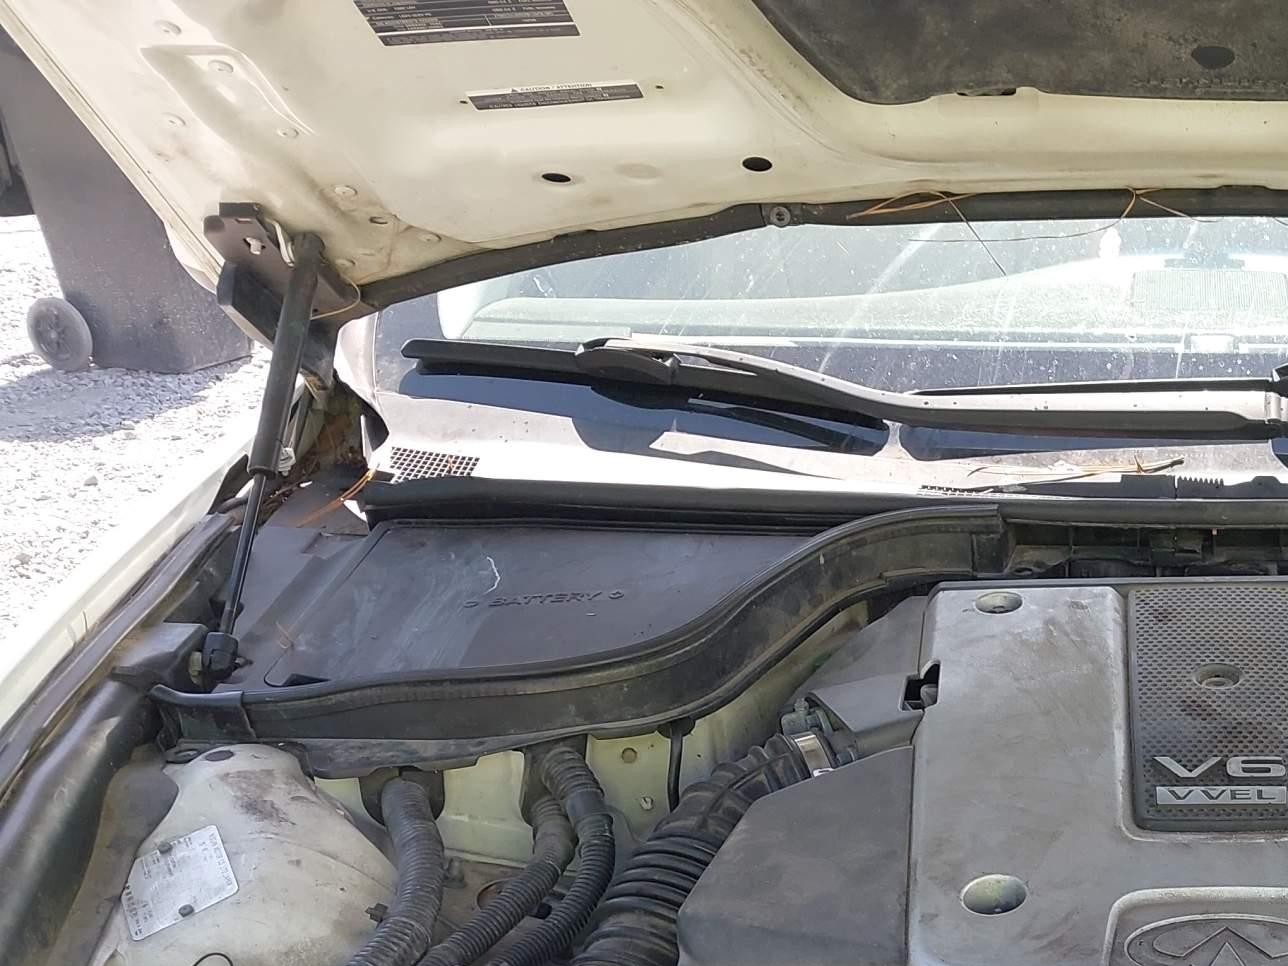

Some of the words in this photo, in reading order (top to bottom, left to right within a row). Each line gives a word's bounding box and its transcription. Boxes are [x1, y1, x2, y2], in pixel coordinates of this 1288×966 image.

[488, 591, 602, 607] BATTERY
[1152, 756, 1287, 778] V6
[1168, 788, 1277, 801] VVEL
